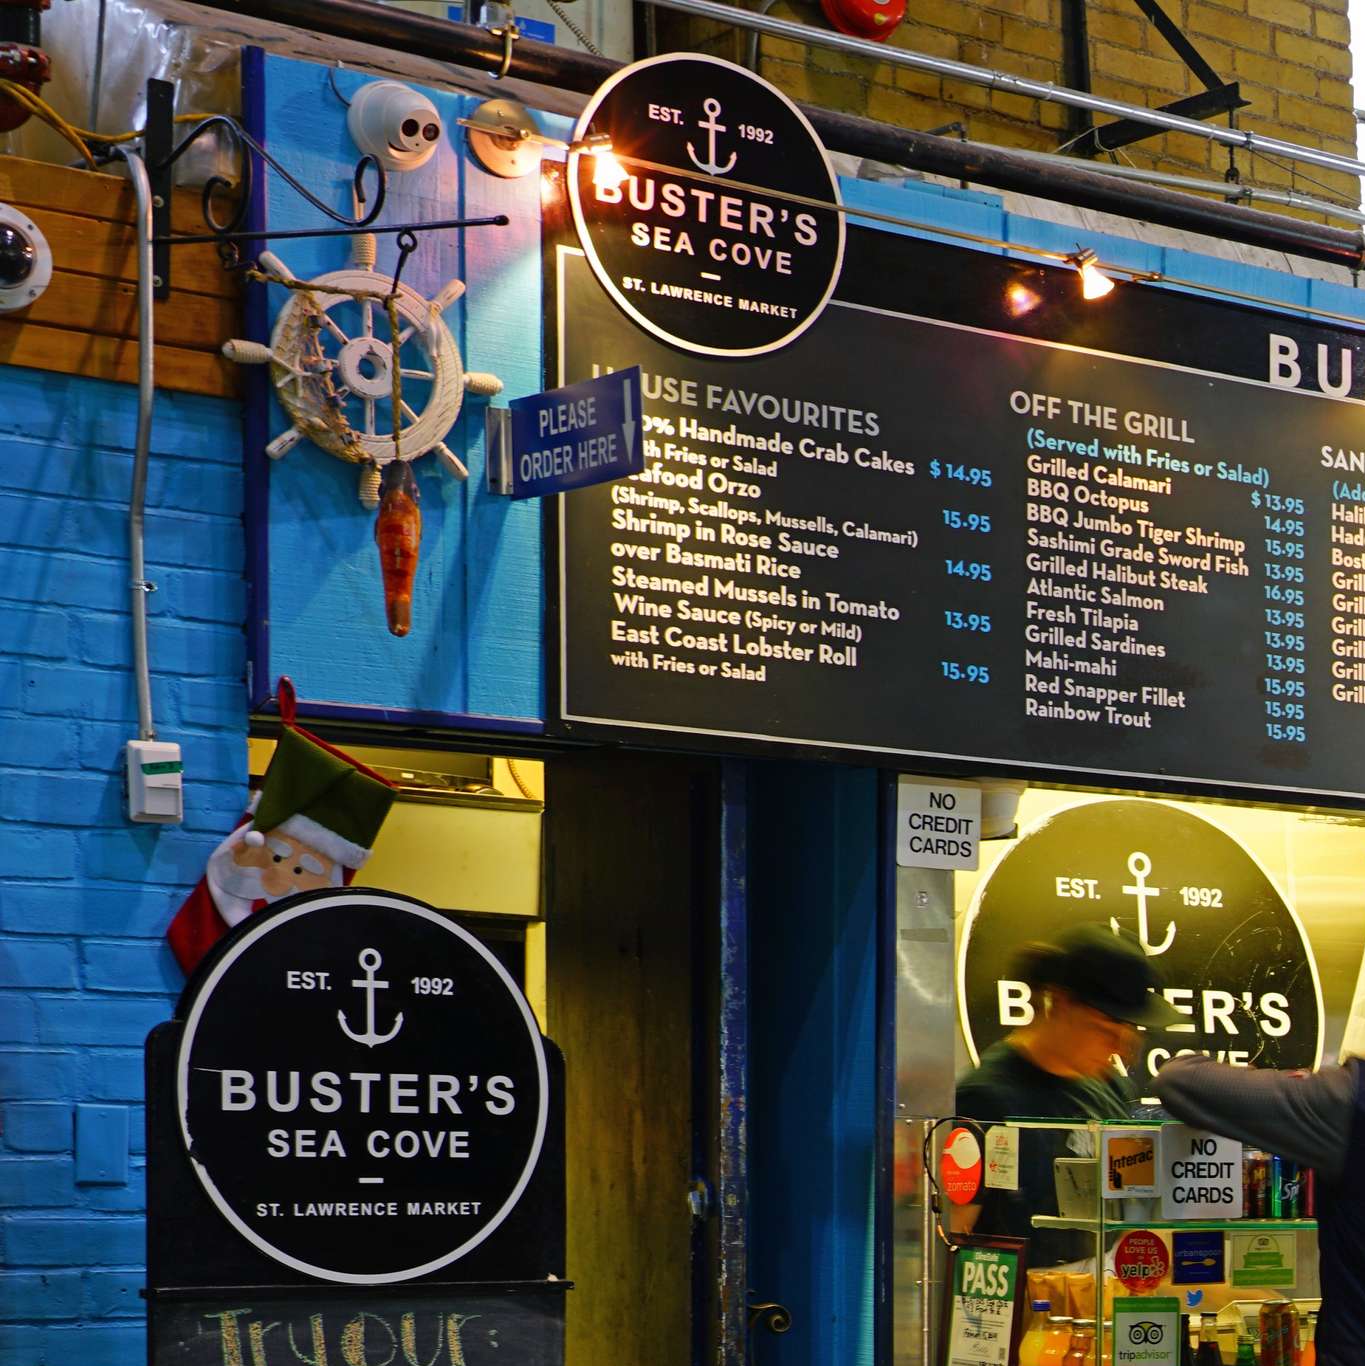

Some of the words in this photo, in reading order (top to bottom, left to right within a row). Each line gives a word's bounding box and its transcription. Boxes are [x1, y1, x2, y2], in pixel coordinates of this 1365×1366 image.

[649, 104, 684, 125] EST.
[738, 125, 774, 144] 1992
[631, 222, 694, 255] SEA
[709, 238, 792, 274] COVE
[622, 276, 645, 292] ST.
[651, 282, 733, 308] LAWRENCE
[739, 299, 798, 319] MARKET
[539, 397, 597, 437] PLEASE
[706, 385, 880, 437] FAVOURITES
[1010, 391, 1062, 419] OFF
[1067, 400, 1118, 431] THE
[1124, 411, 1195, 443] GRILL
[520, 444, 572, 482] ORDER
[578, 434, 617, 470] HERE
[1027, 455, 1089, 481] Grilled
[1093, 465, 1172, 495] Calamari
[611, 620, 660, 646] East
[664, 626, 728, 653] Coast
[733, 634, 814, 663] Lobster
[819, 644, 857, 666] Roll
[941, 661, 990, 684] 15.95
[929, 793, 956, 810] NO
[908, 815, 973, 836] CREDIT
[909, 837, 971, 858] CARDS
[1056, 877, 1101, 899] EST.
[1179, 887, 1223, 908] 1992
[287, 971, 332, 991] EST.
[410, 976, 454, 996] 1992
[220, 1069, 516, 1117] BUSTER'S
[266, 1129, 346, 1159] SEA
[366, 1130, 471, 1159] COVE
[1191, 1138, 1216, 1155] NO
[1171, 1161, 1234, 1180] CREDIT
[947, 1181, 977, 1193] zomato
[1172, 1186, 1233, 1204] CARDS
[256, 1203, 285, 1217] ST.
[293, 1202, 399, 1217] LAWRENCE
[406, 1200, 482, 1217] MARKET
[1124, 1246, 1144, 1255] LOVE
[962, 1261, 1009, 1297] PASS
[1121, 1263, 1152, 1280] yelp
[1119, 1350, 1171, 1362] tripadvisor
